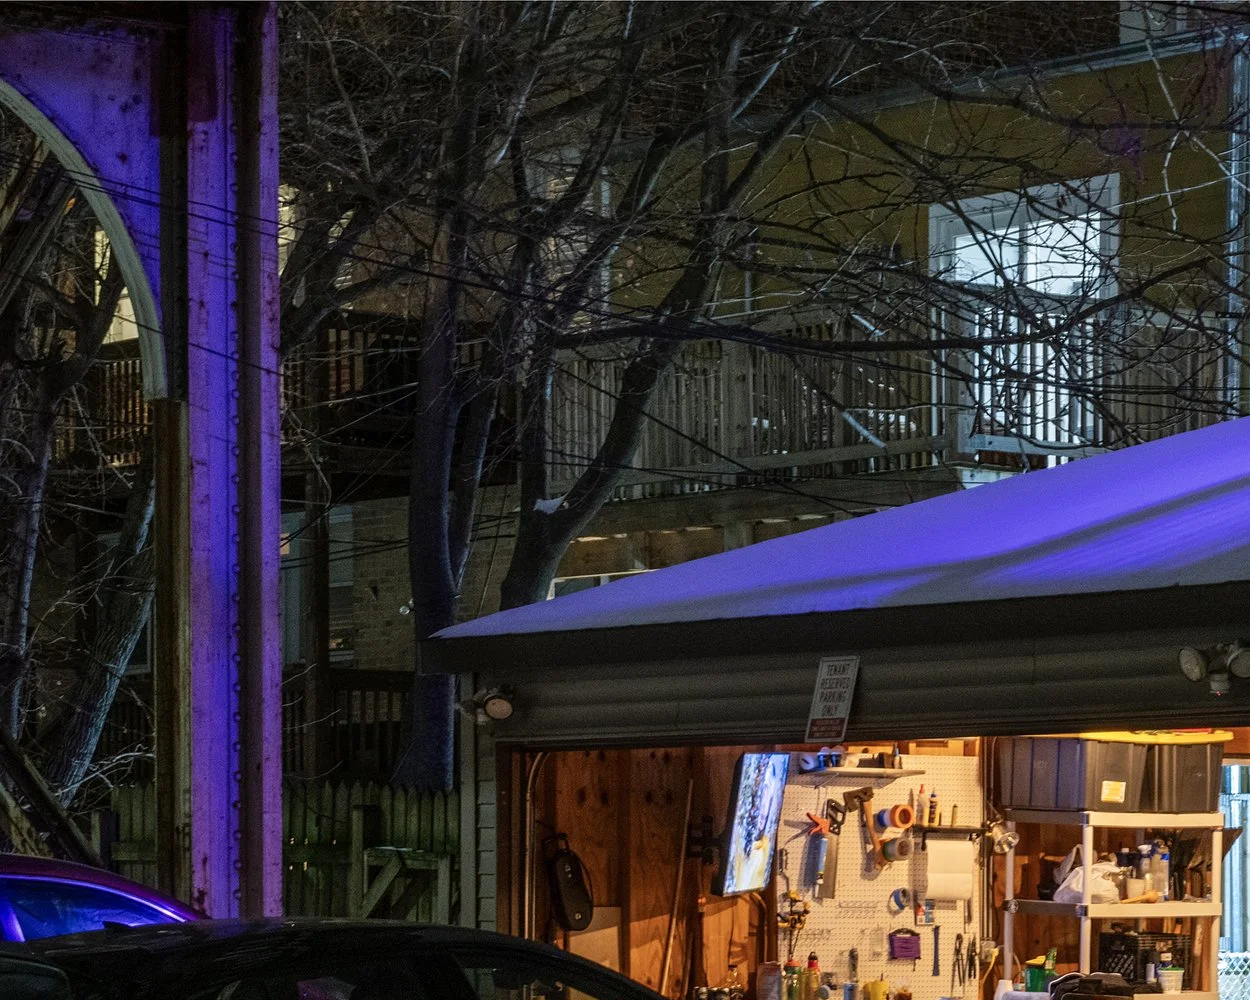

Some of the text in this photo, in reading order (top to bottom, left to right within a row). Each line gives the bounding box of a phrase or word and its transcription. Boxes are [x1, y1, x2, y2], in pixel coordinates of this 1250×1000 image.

[826, 663, 850, 676] TENANT
[820, 677, 851, 689] RESERVED
[819, 690, 847, 703] PARKING
[821, 704, 840, 717] ONLY
